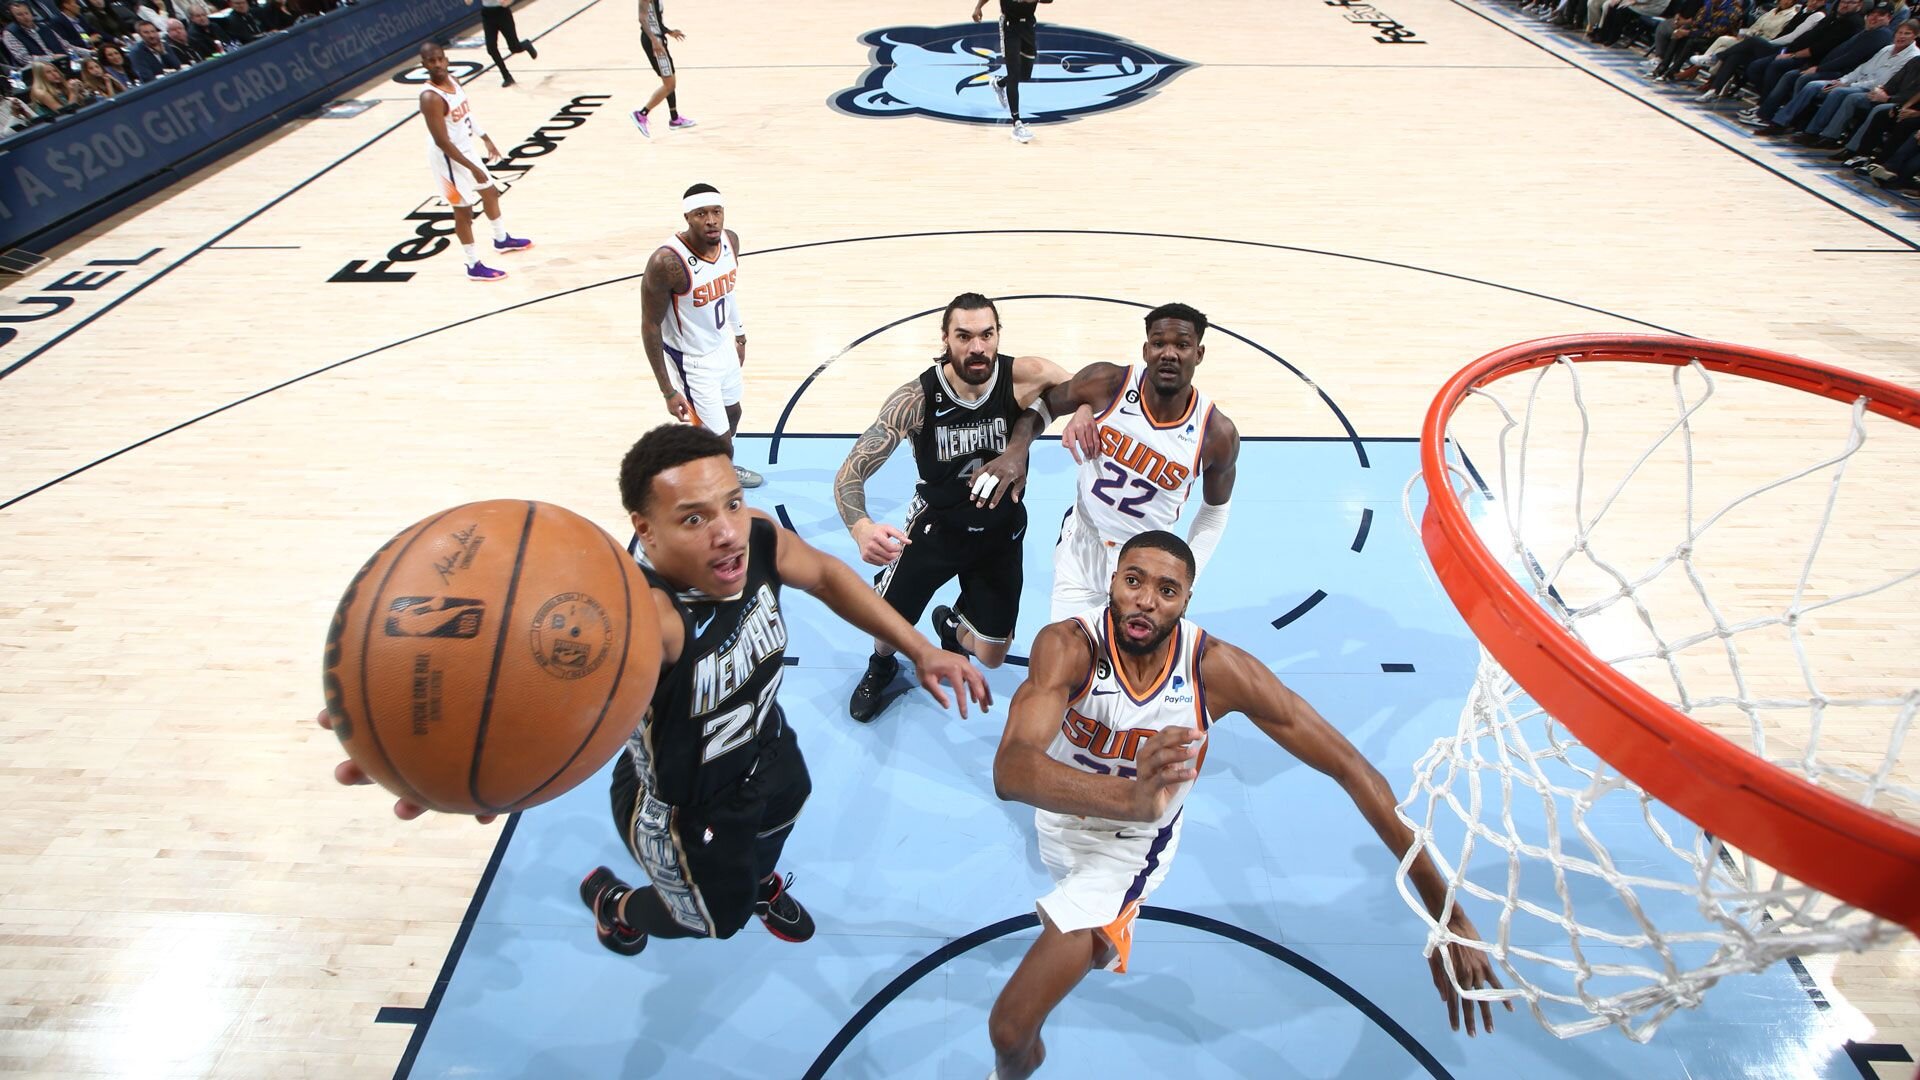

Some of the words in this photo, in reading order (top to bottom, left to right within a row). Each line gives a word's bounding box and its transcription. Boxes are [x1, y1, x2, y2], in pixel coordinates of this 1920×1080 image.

[14, 165, 57, 207] A
[46, 123, 146, 191] $200
[142, 90, 216, 145] GIFT
[211, 62, 288, 113] CARD
[288, 54, 312, 81] at
[326, 95, 612, 282] FedForum
[714, 297, 726, 330] 0
[935, 393, 942, 402] 6
[1128, 391, 1137, 402] 6
[935, 417, 1008, 461] MEMPHIS
[1100, 425, 1190, 491] SUNS
[1091, 461, 1158, 519] 22
[1164, 695, 1193, 704] PayPal
[1061, 707, 1160, 761] SUN
